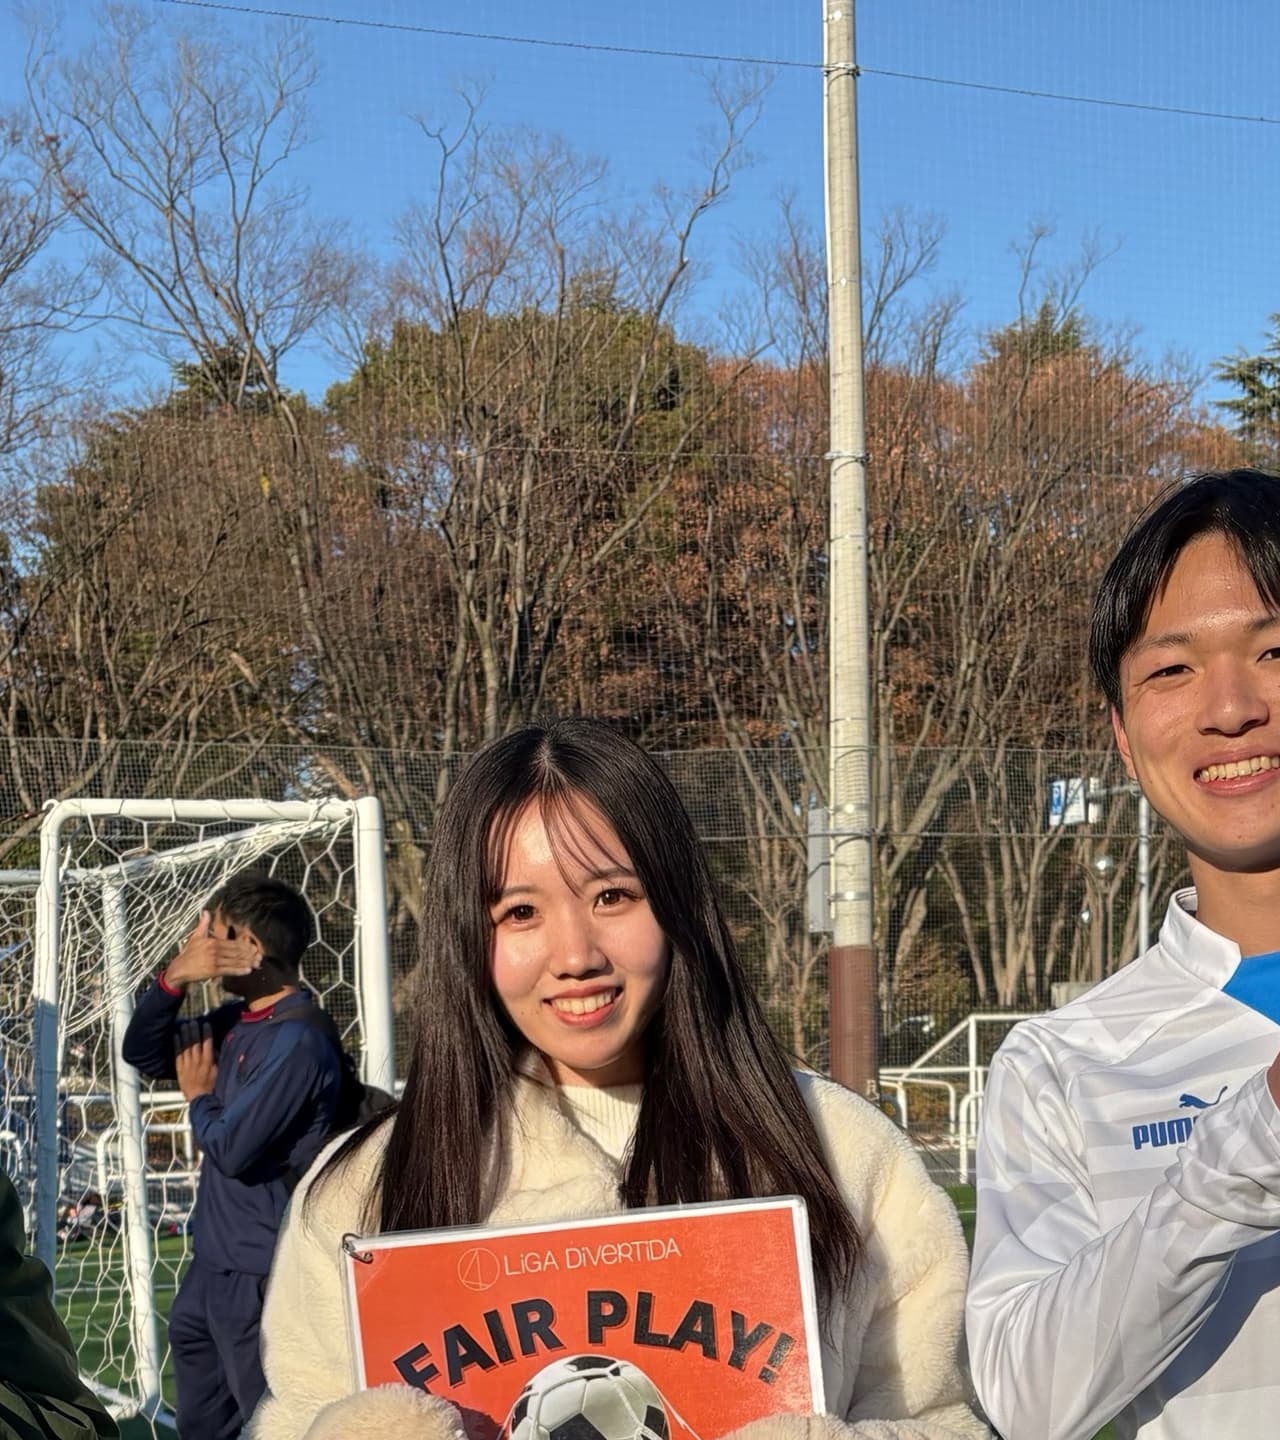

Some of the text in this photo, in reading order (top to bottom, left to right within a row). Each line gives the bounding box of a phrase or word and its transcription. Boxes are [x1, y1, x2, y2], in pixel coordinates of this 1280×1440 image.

[1132, 1115, 1199, 1150] PUM
[393, 1290, 797, 1394] FAIR PLAY!
